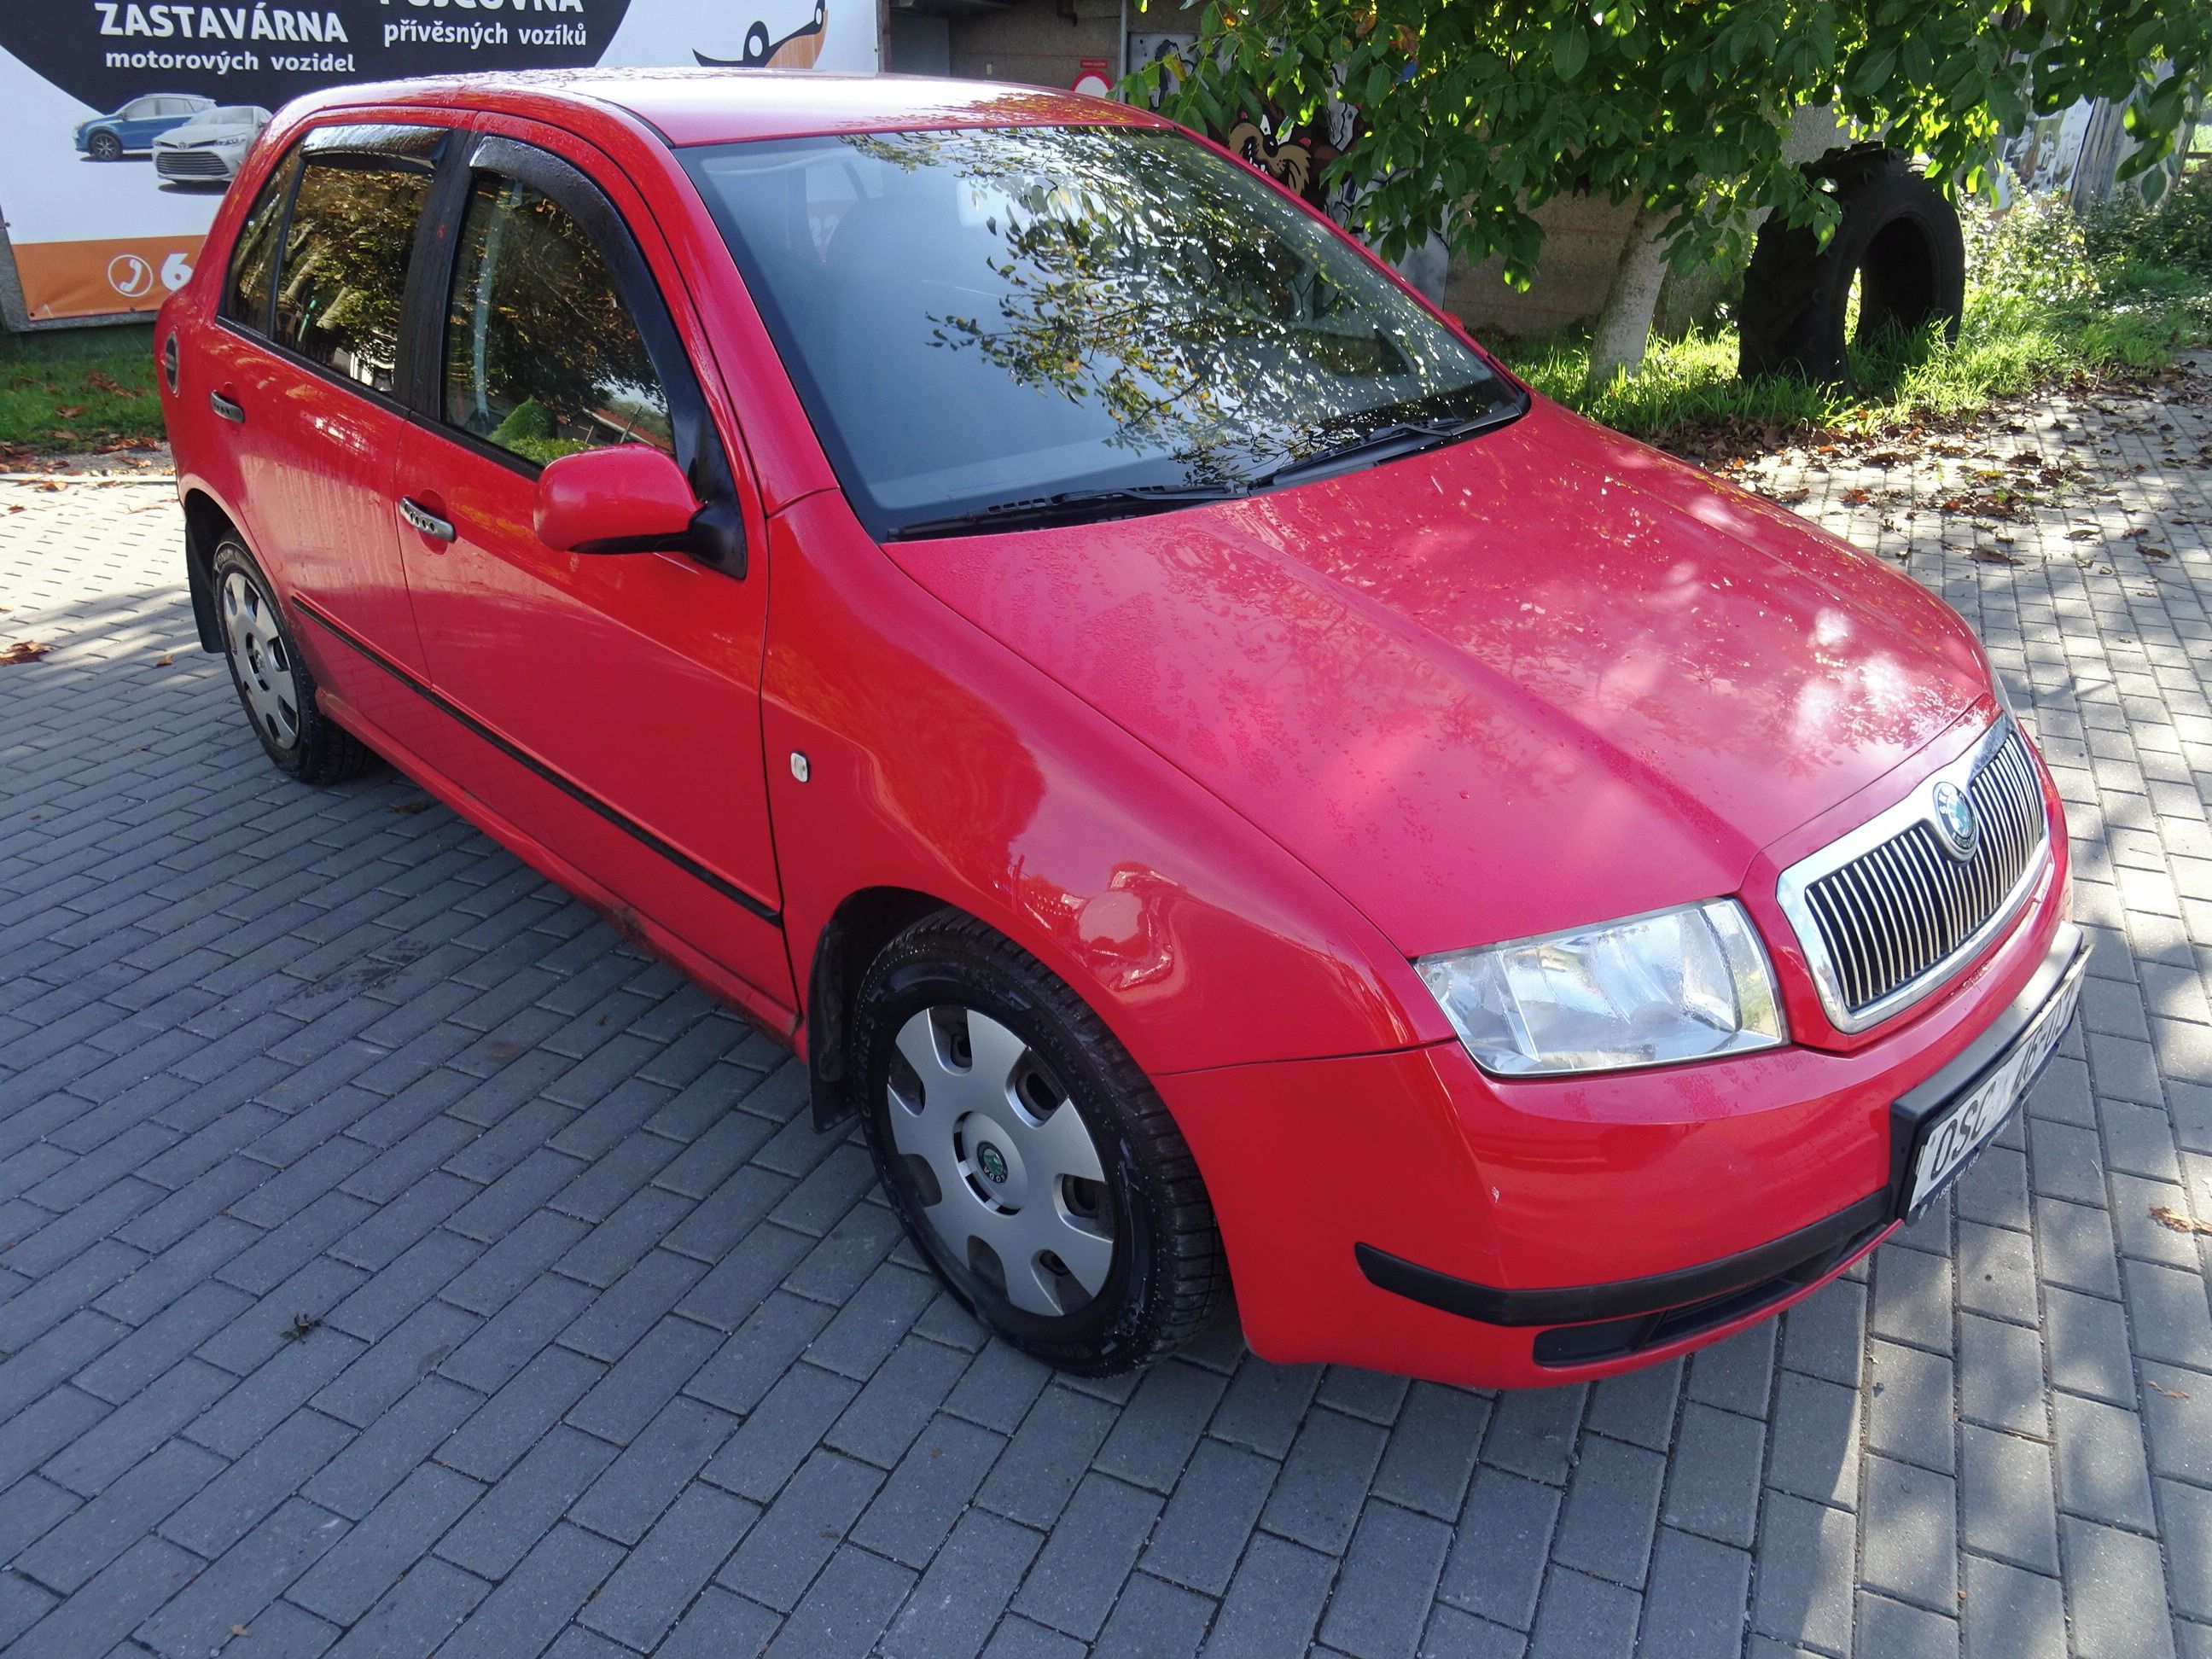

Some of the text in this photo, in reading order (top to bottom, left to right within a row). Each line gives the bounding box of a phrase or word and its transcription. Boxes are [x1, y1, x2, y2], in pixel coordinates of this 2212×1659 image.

[94, 3, 349, 43] ZASTAVÁRNA
[384, 19, 586, 49] přívěsných vozíků
[106, 51, 356, 75] motorových vozidel
[161, 253, 194, 292] 6
